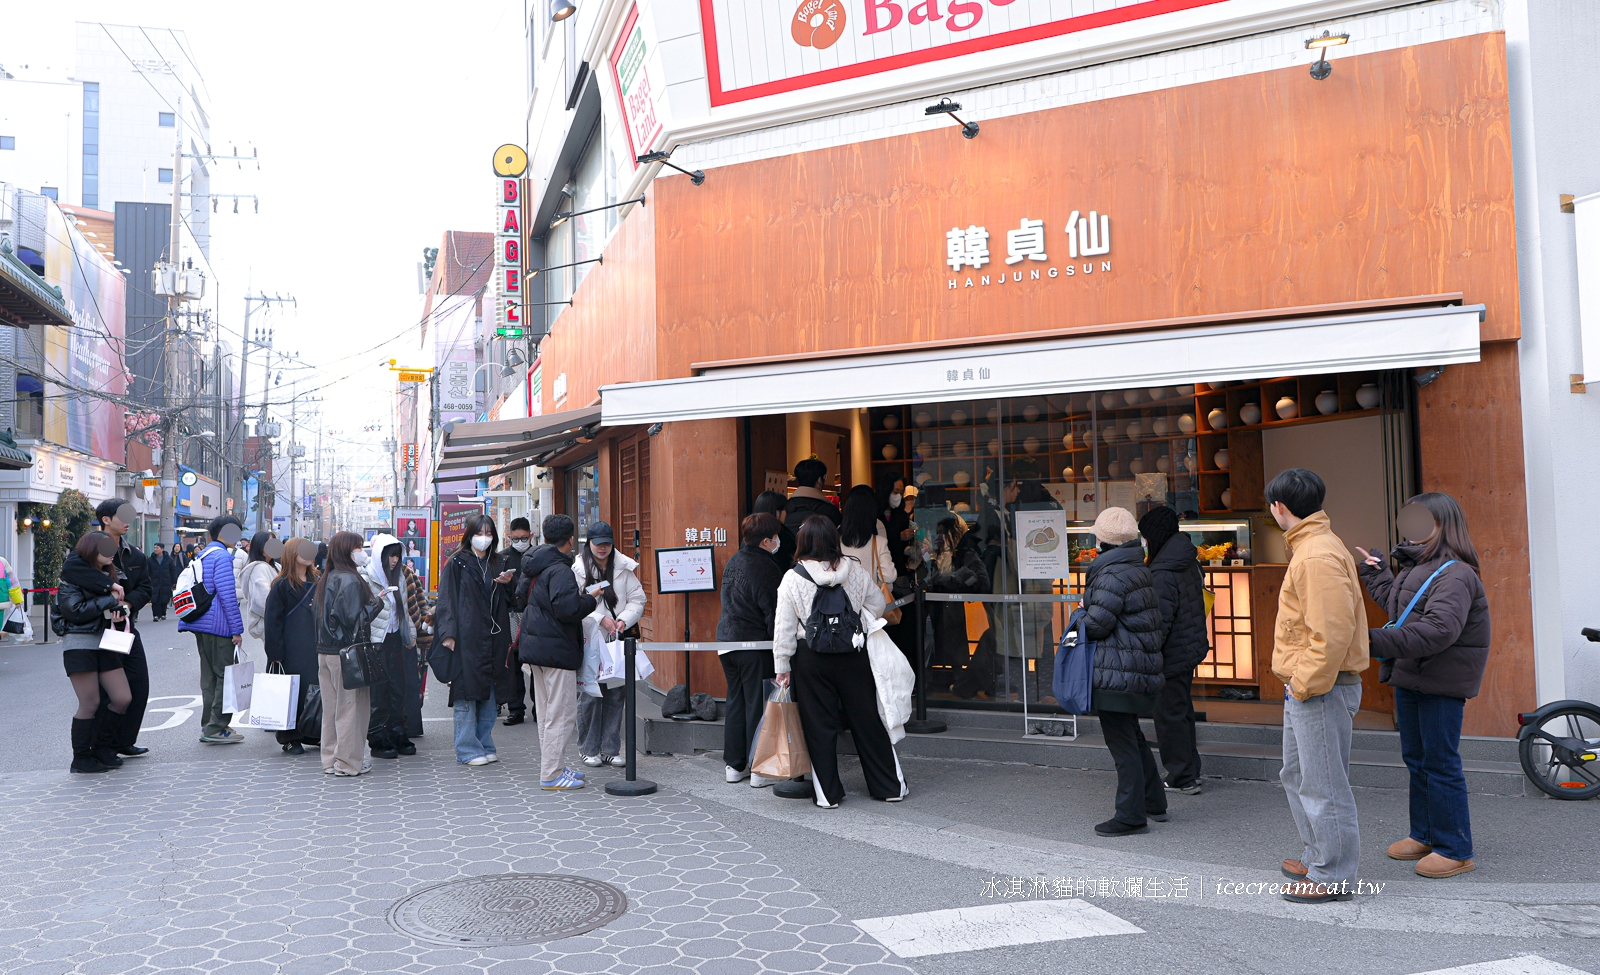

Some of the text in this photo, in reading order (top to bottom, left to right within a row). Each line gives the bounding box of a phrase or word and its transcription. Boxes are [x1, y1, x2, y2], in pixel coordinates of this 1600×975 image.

[798, 0, 837, 31] Bagel Land
[862, 0, 1016, 36] Bag
[628, 64, 651, 122] Bagel
[635, 97, 657, 149] Land
[503, 179, 519, 322] BAGEL
[946, 210, 1110, 272] 韓貞仙
[948, 260, 1112, 290] HANJUNGSUN
[70, 331, 111, 376] Weatherwear
[448, 362, 469, 399] 부동산
[946, 367, 991, 383] 韓貞仙
[444, 518, 462, 527] Google
[685, 527, 727, 543] 韓貞仙
